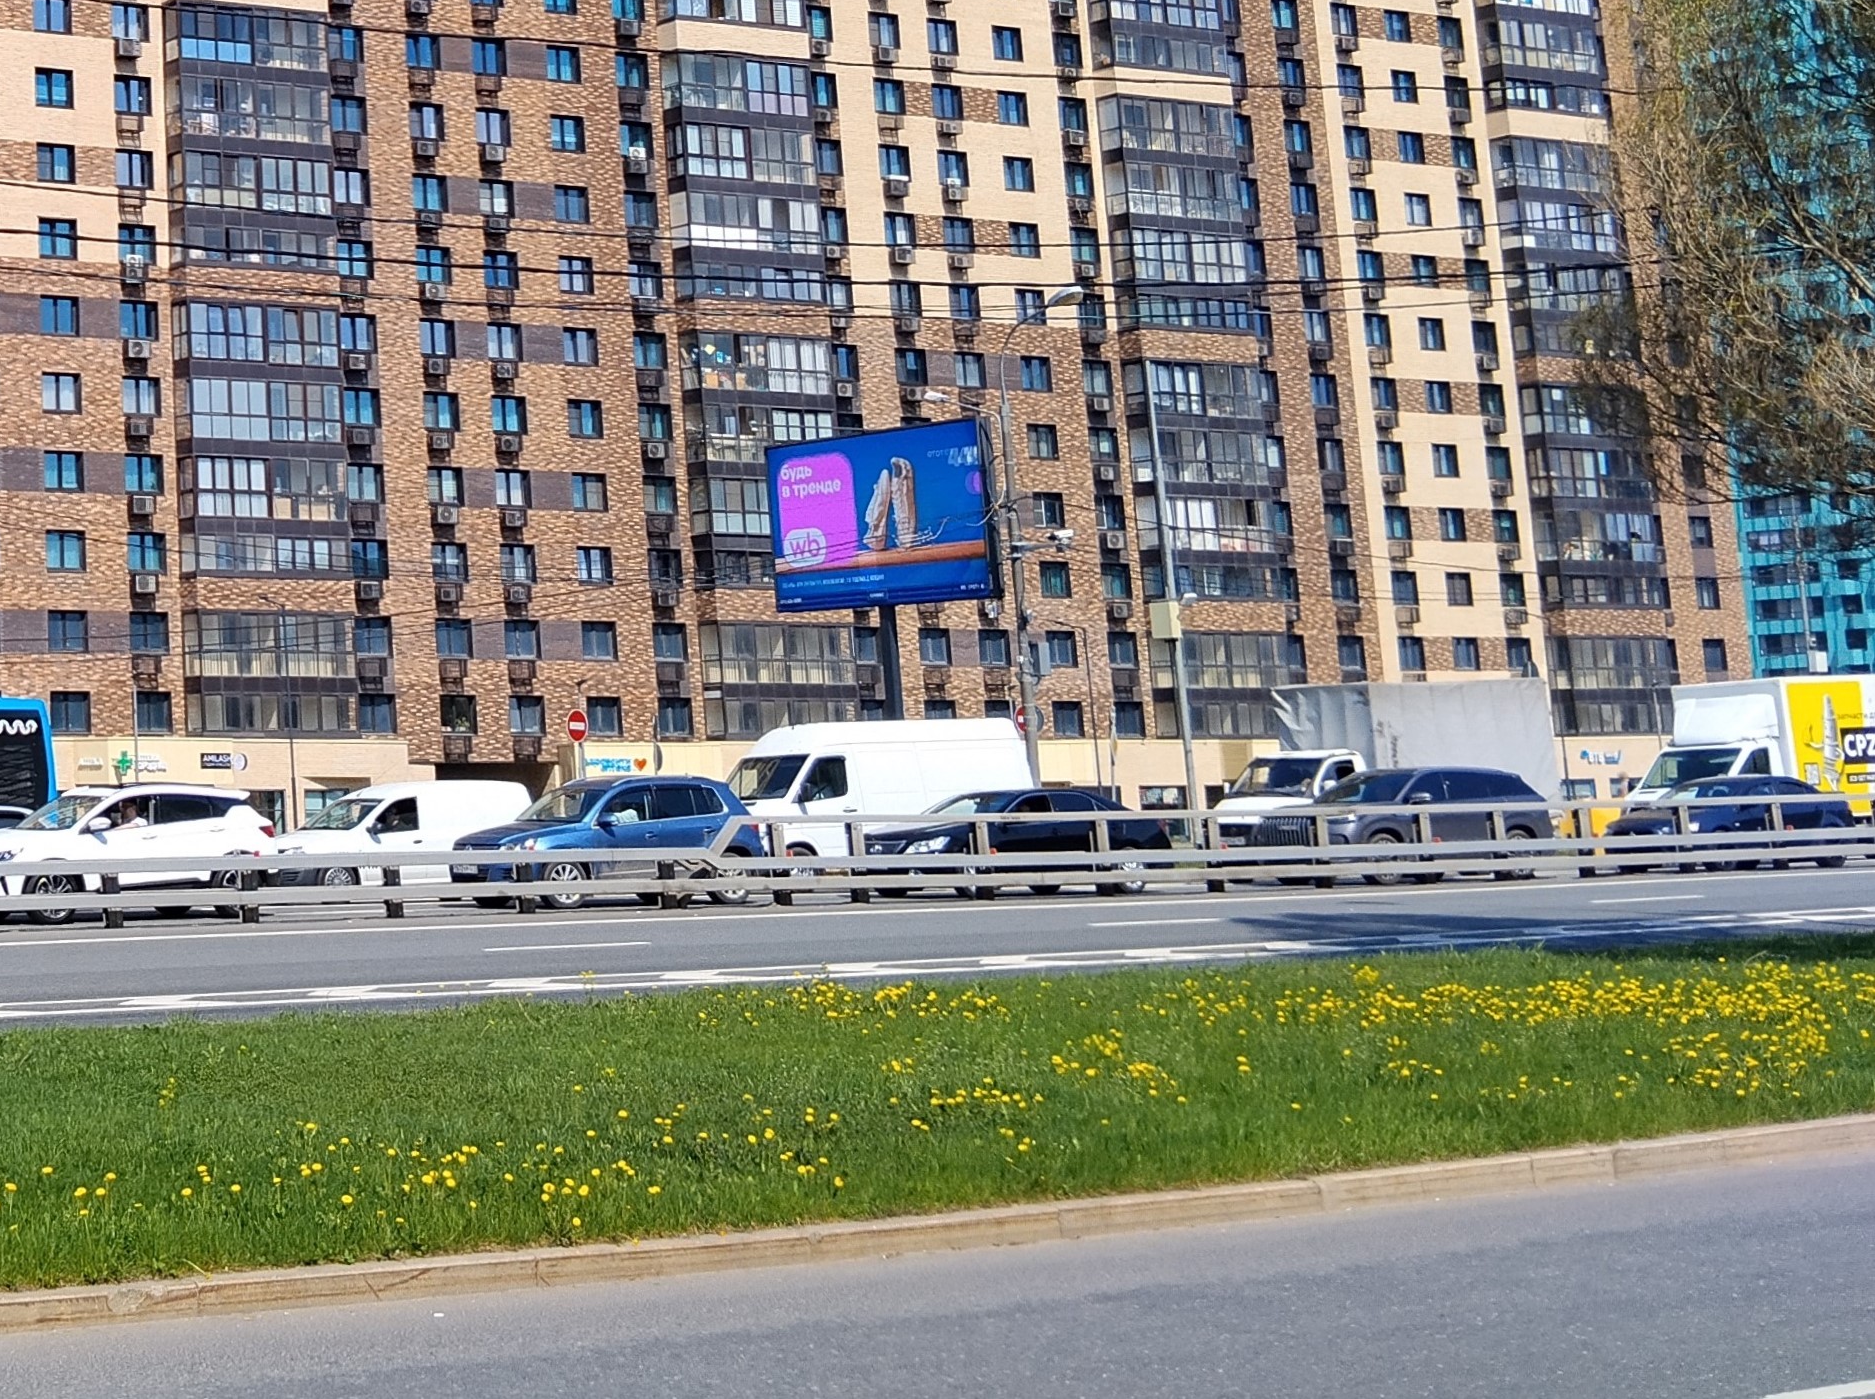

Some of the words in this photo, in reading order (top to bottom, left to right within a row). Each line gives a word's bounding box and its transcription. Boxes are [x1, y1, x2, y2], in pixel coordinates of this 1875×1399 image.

[780, 464, 812, 482] будь
[782, 485, 790, 498] в
[792, 479, 841, 499] тренде
[789, 532, 820, 558] wb
